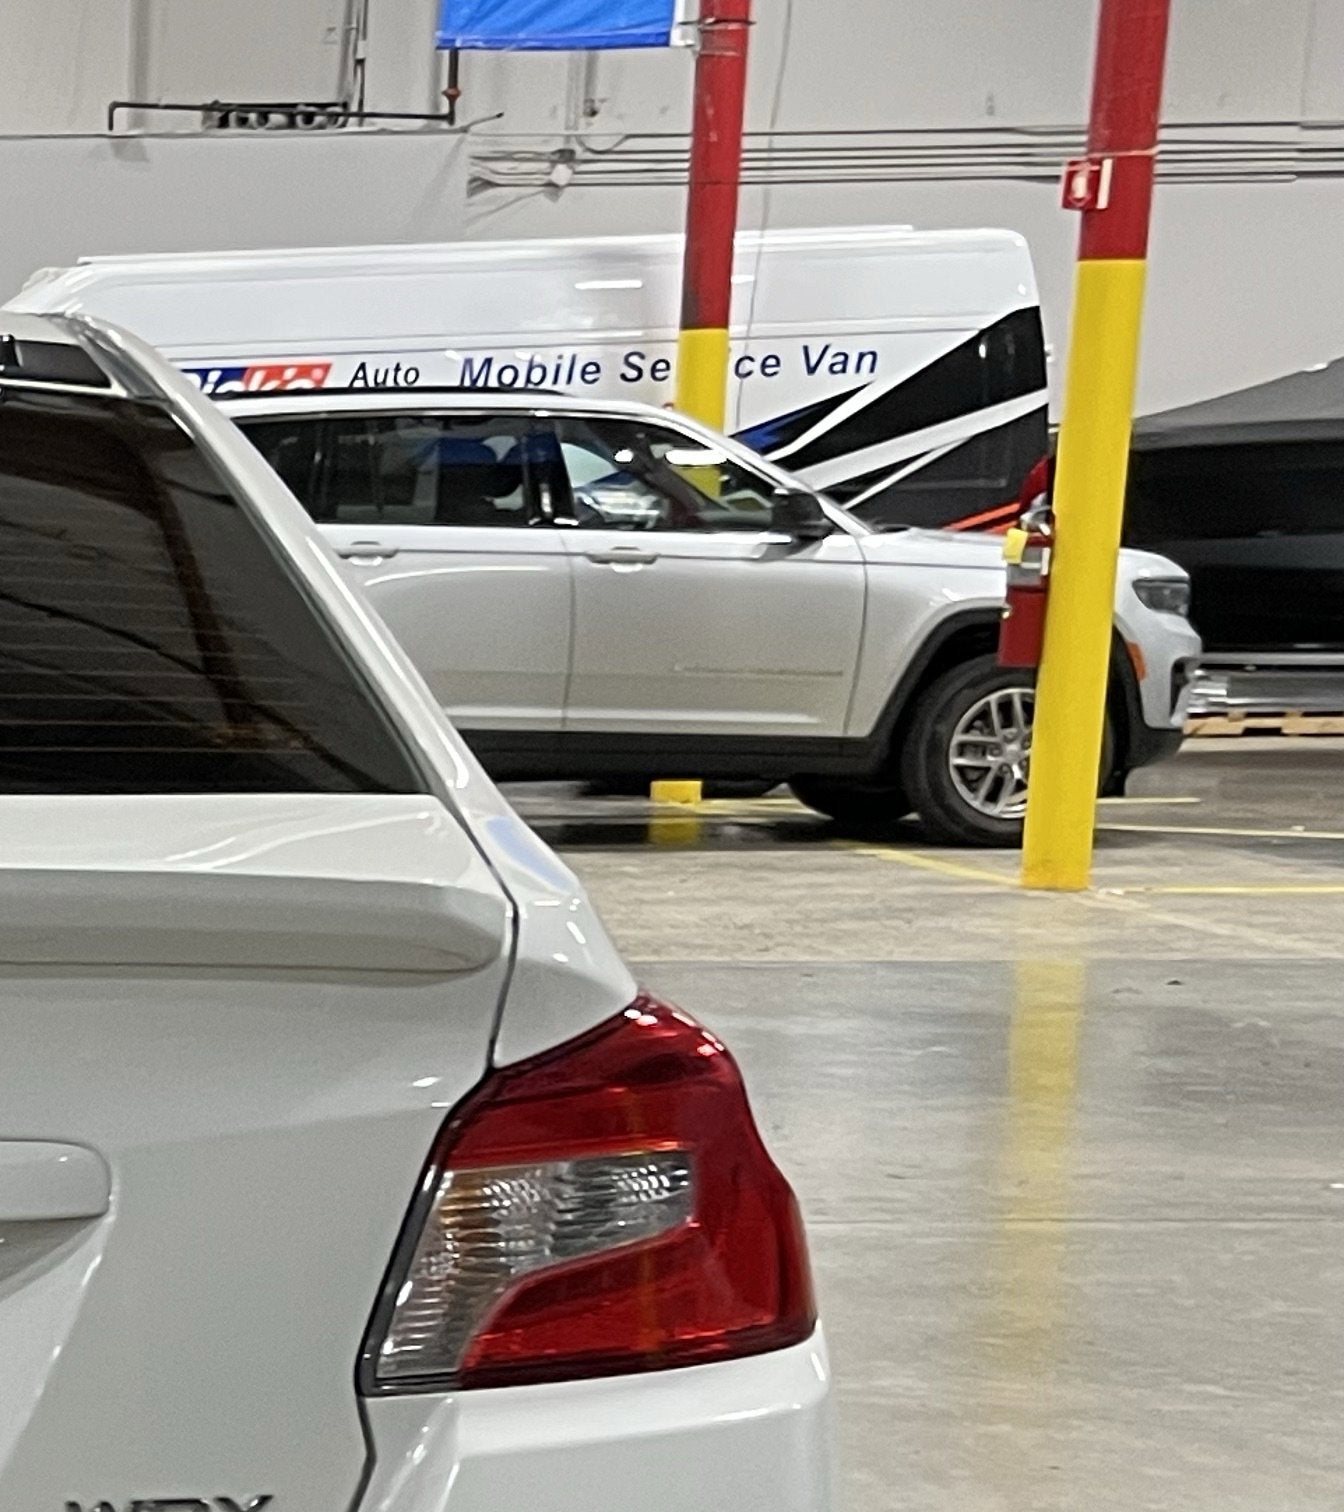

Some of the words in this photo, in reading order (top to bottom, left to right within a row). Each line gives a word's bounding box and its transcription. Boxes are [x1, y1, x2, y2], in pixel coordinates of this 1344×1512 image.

[348, 361, 421, 389] Auto
[460, 353, 603, 388] Mobile
[802, 344, 878, 377] Van
